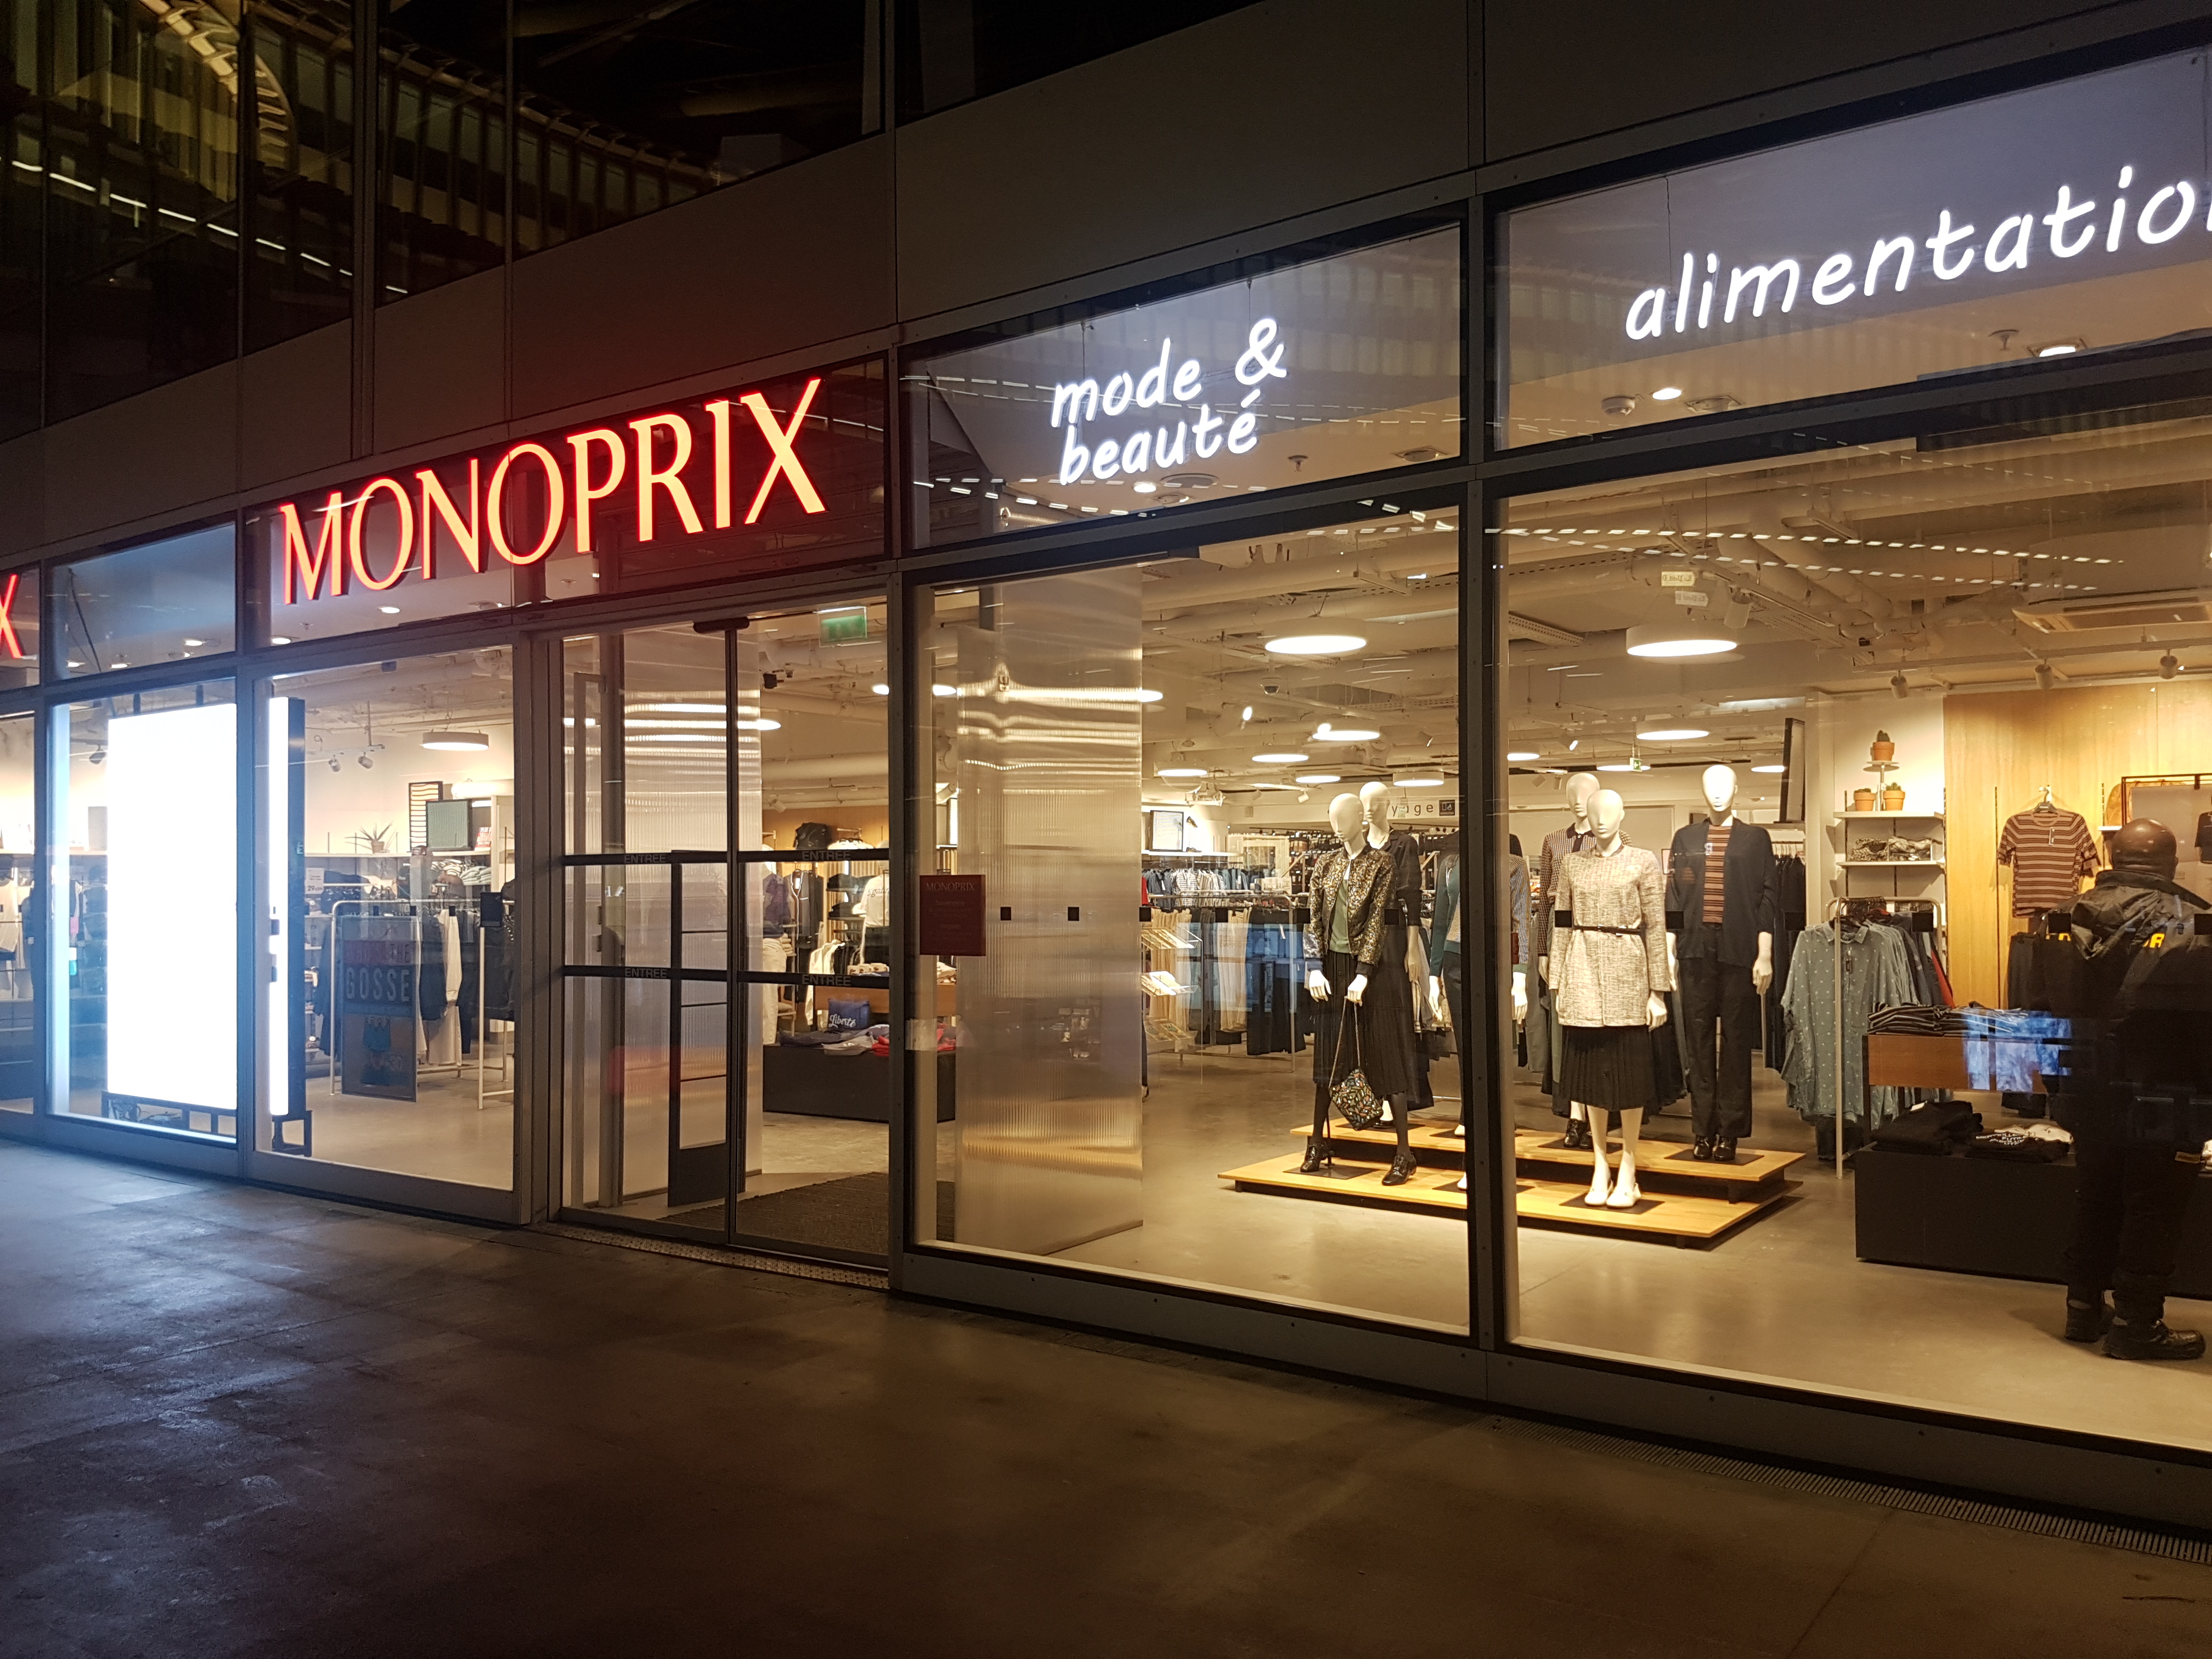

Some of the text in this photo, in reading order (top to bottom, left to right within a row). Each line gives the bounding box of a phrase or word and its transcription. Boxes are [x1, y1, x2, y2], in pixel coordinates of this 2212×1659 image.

[1624, 166, 2212, 341] alimentatio
[1051, 317, 1287, 428] mode &
[1059, 387, 1258, 486] beauté
[279, 377, 827, 606] MONOPRIX
[926, 882, 975, 891] MONOPRIX
[346, 966, 410, 1002] GOSSE
[625, 967, 667, 978] ENTREE
[802, 974, 851, 986] ENTREE
[828, 1013, 856, 1029] Liberté
